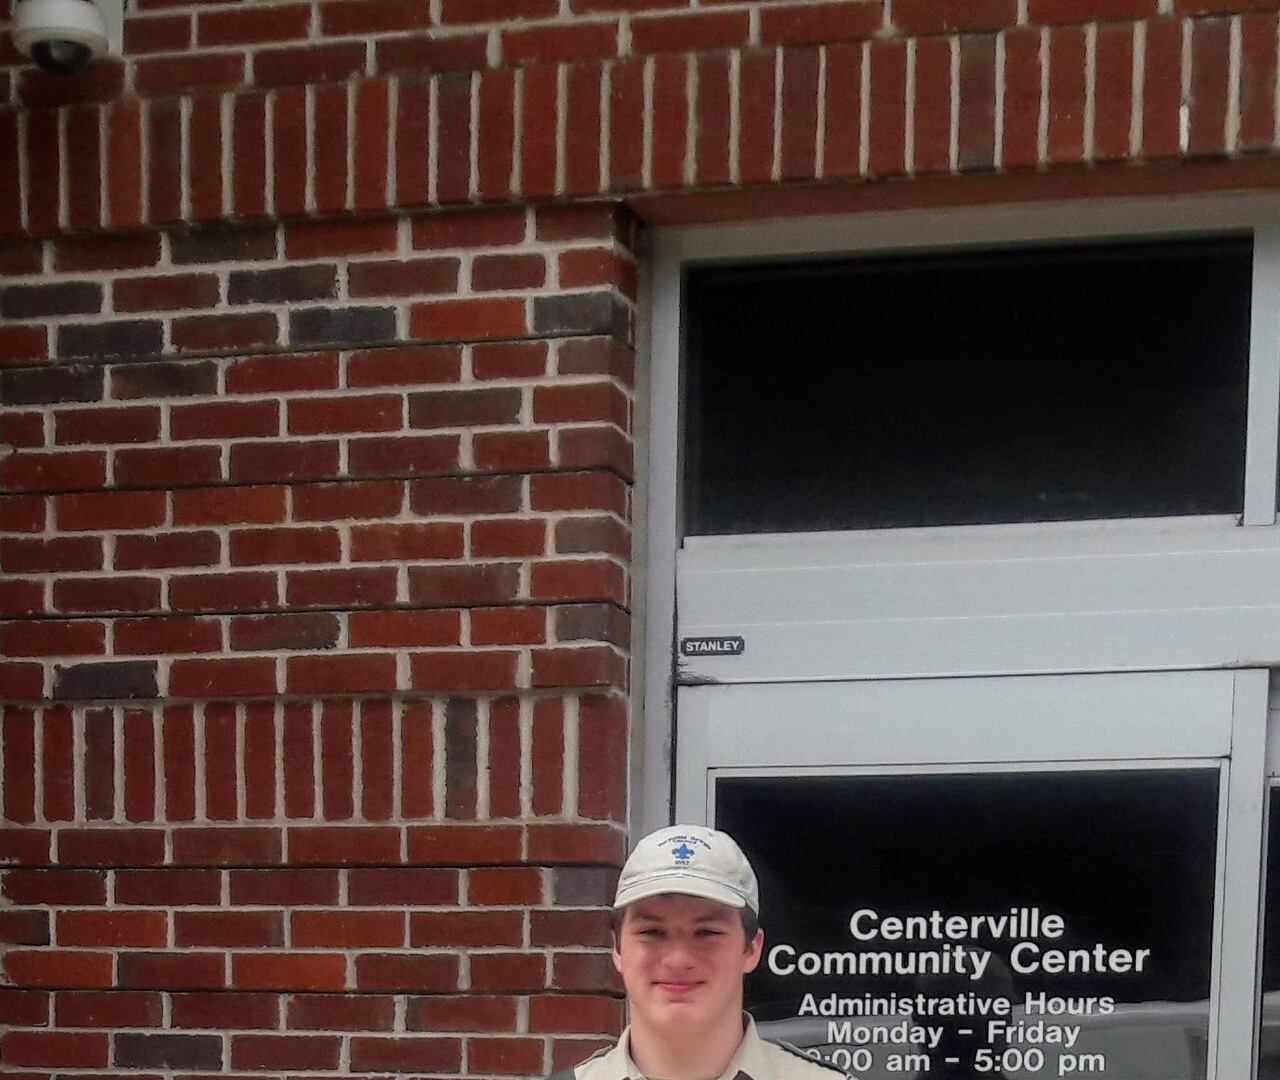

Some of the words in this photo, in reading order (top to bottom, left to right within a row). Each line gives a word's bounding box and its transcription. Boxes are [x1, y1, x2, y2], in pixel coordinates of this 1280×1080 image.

[685, 640, 740, 652] STANLEY
[849, 907, 1066, 941] Centerville
[766, 943, 993, 980] Community
[1009, 942, 1151, 974] Center
[797, 992, 1011, 1016] Administrative
[1025, 991, 1116, 1015] Hours
[826, 1020, 944, 1045] Monday
[987, 1019, 1082, 1047] Friday
[885, 1053, 931, 1073] am
[973, 1048, 1045, 1073] 5:00
[1057, 1053, 1106, 1077] pm
